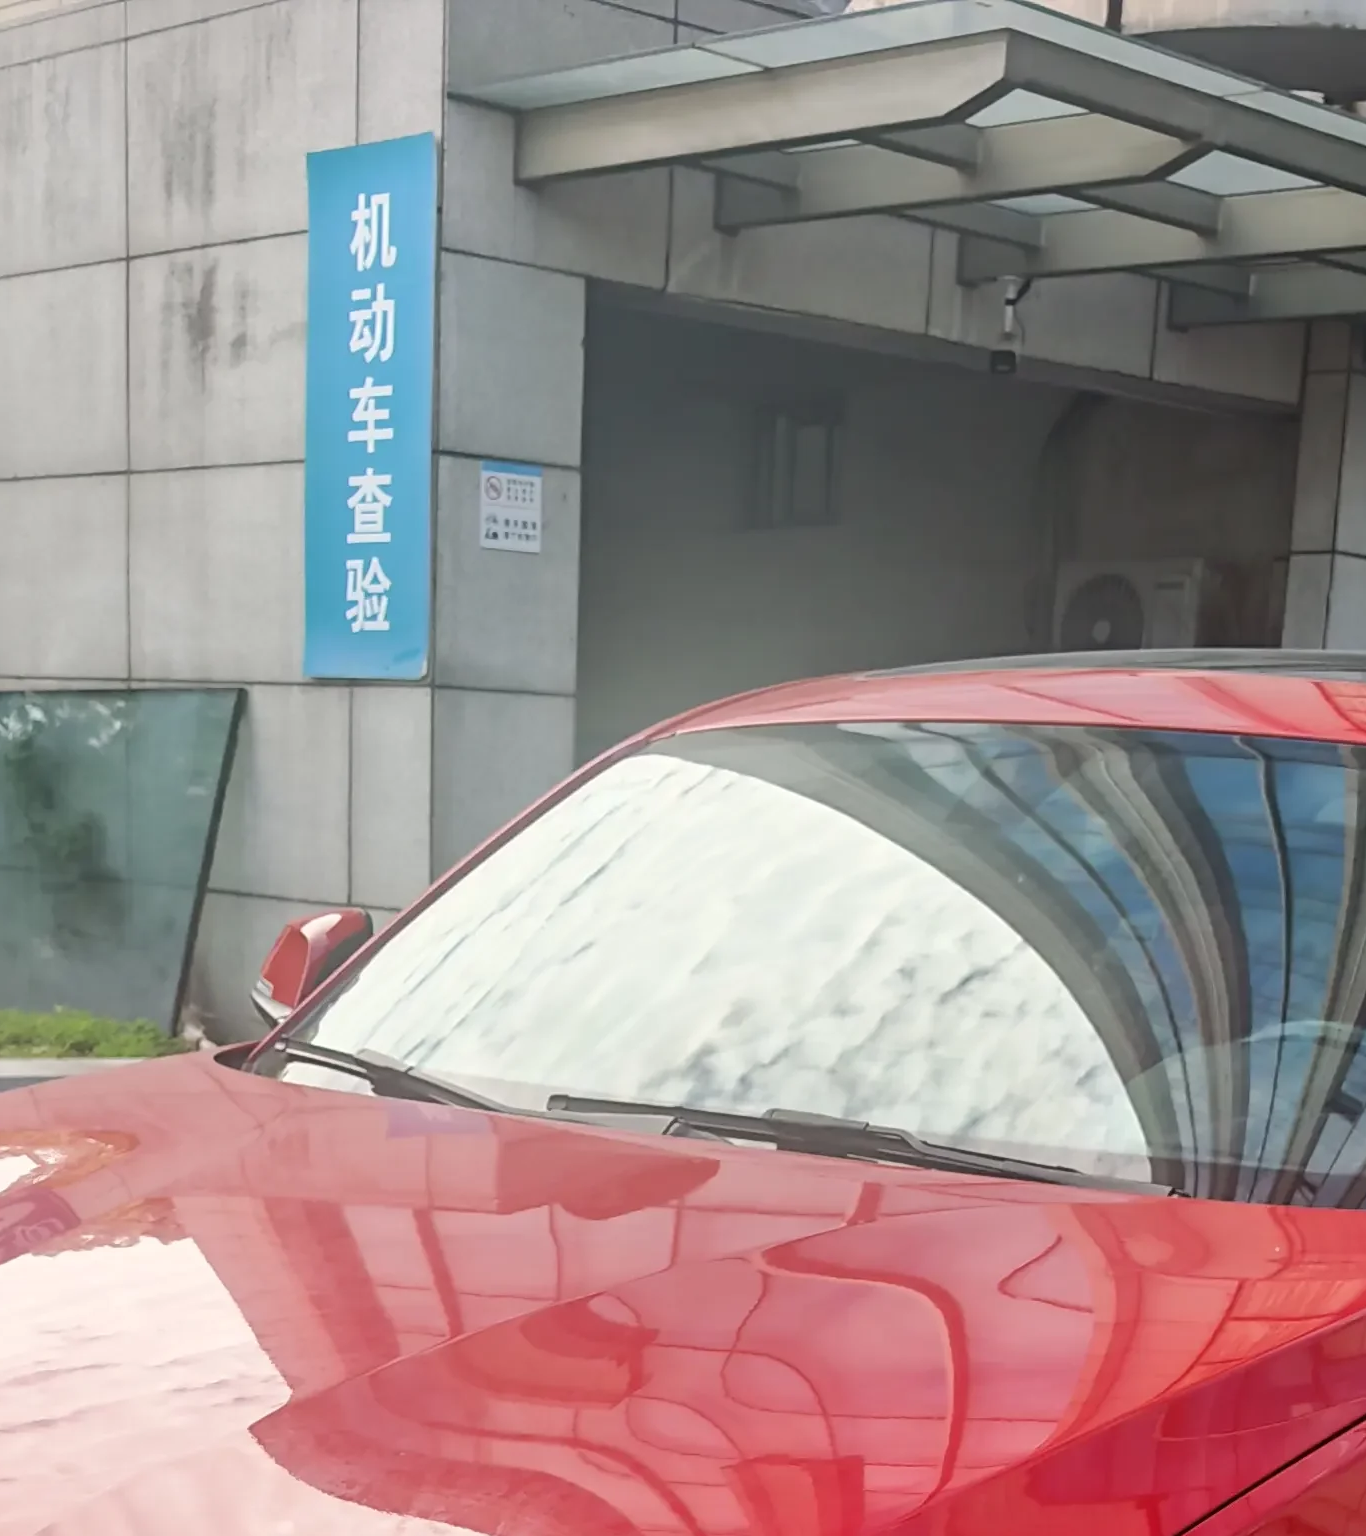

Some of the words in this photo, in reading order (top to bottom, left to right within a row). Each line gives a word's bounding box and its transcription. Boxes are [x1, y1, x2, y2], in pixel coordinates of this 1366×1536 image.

[346, 193, 397, 633] 机动车查验
